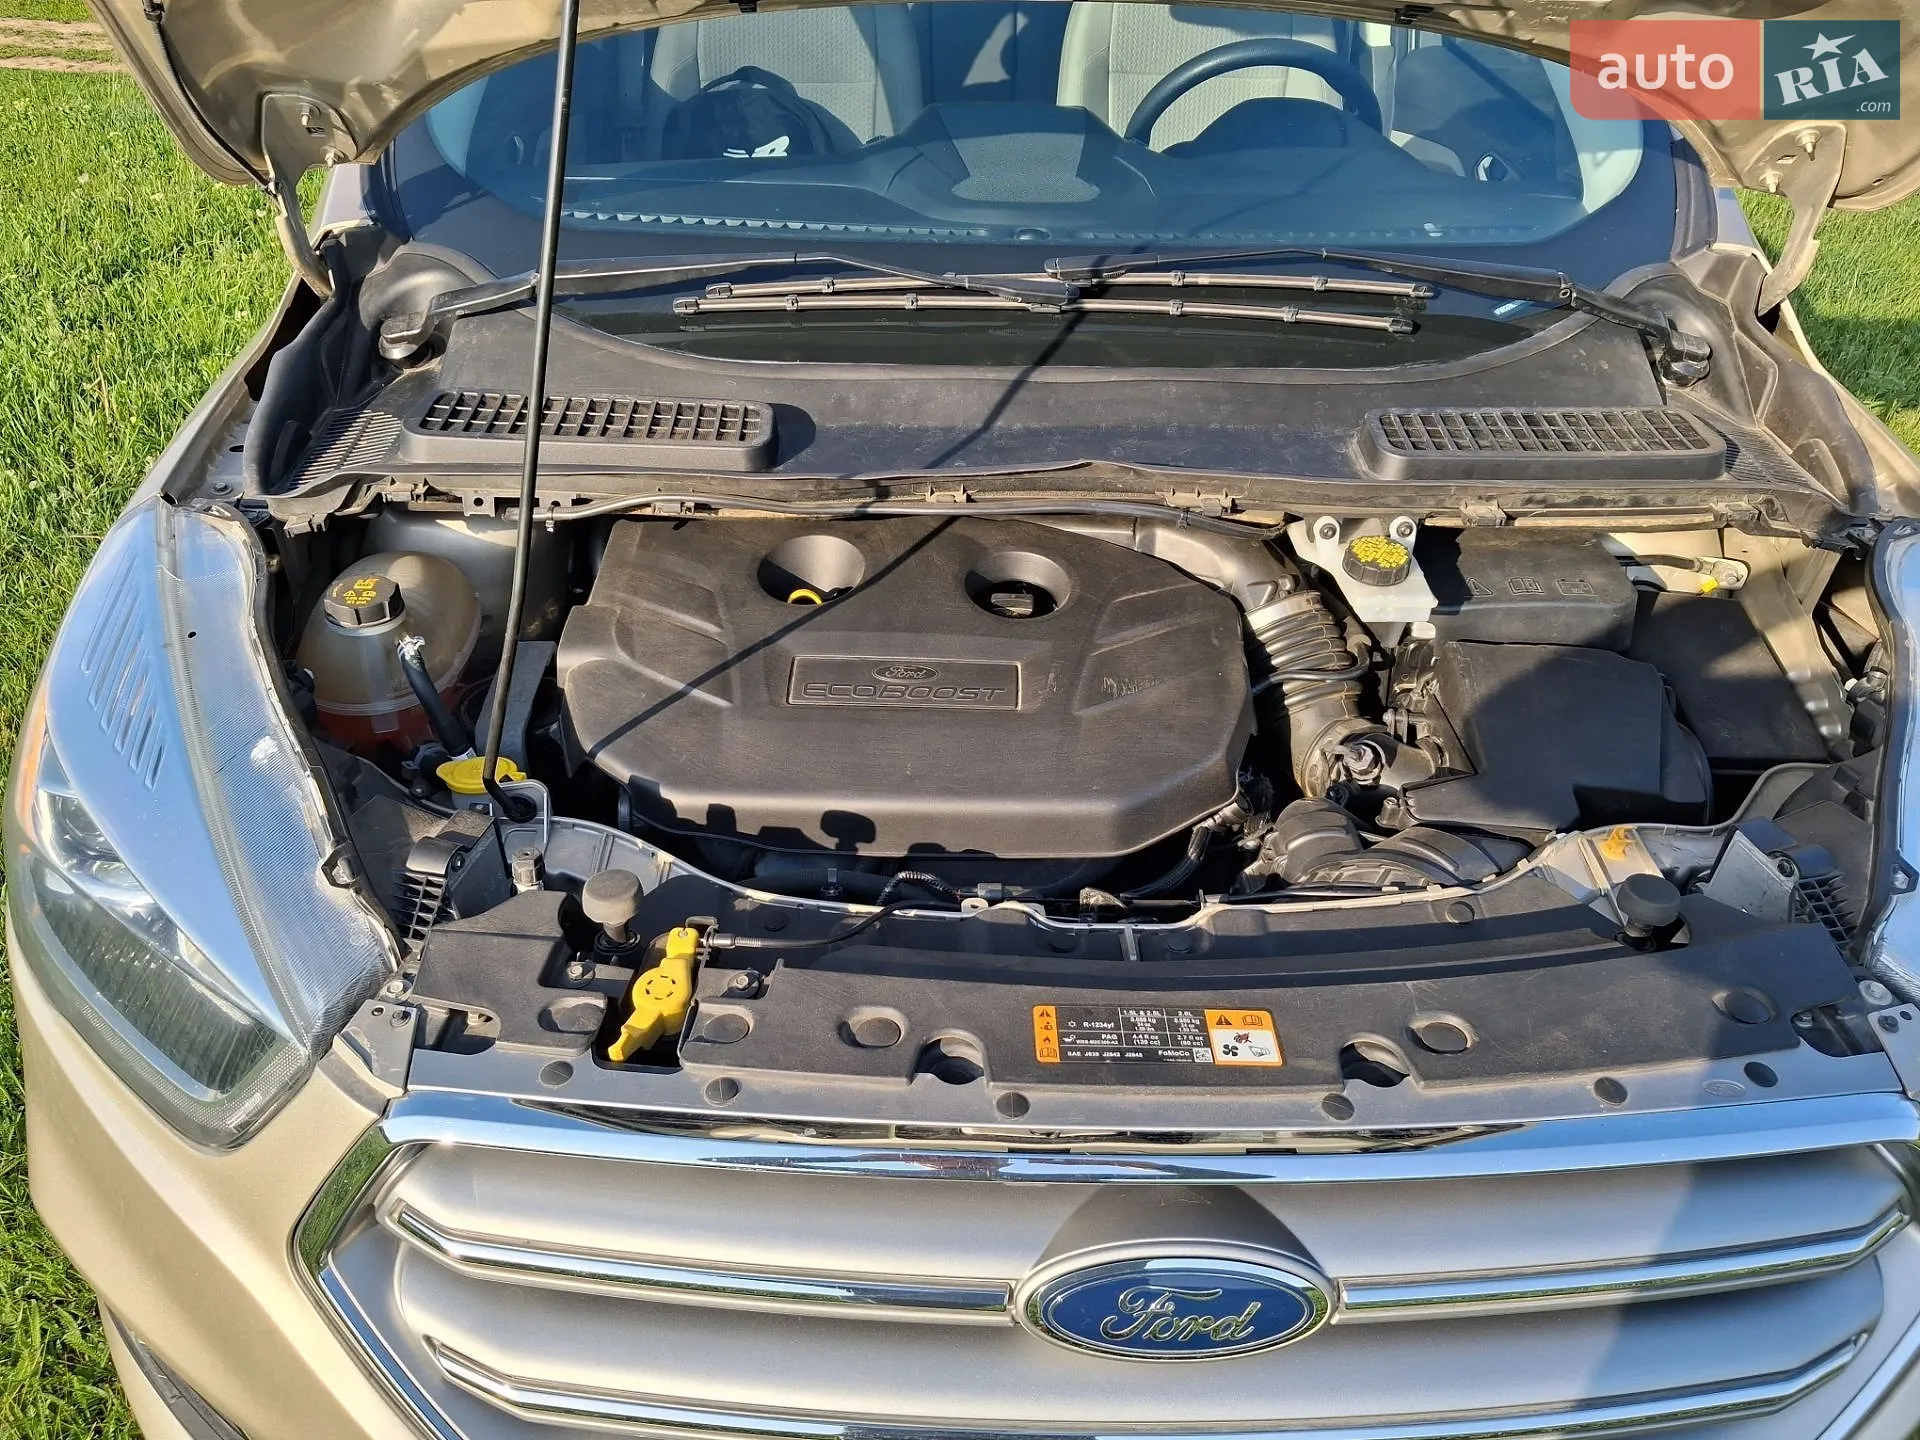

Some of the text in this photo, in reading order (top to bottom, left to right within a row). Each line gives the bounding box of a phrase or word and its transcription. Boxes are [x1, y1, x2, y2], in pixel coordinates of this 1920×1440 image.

[884, 666, 927, 680] Ford
[801, 682, 1006, 702] ECOBOOST
[1099, 1285, 1262, 1342] Ford
